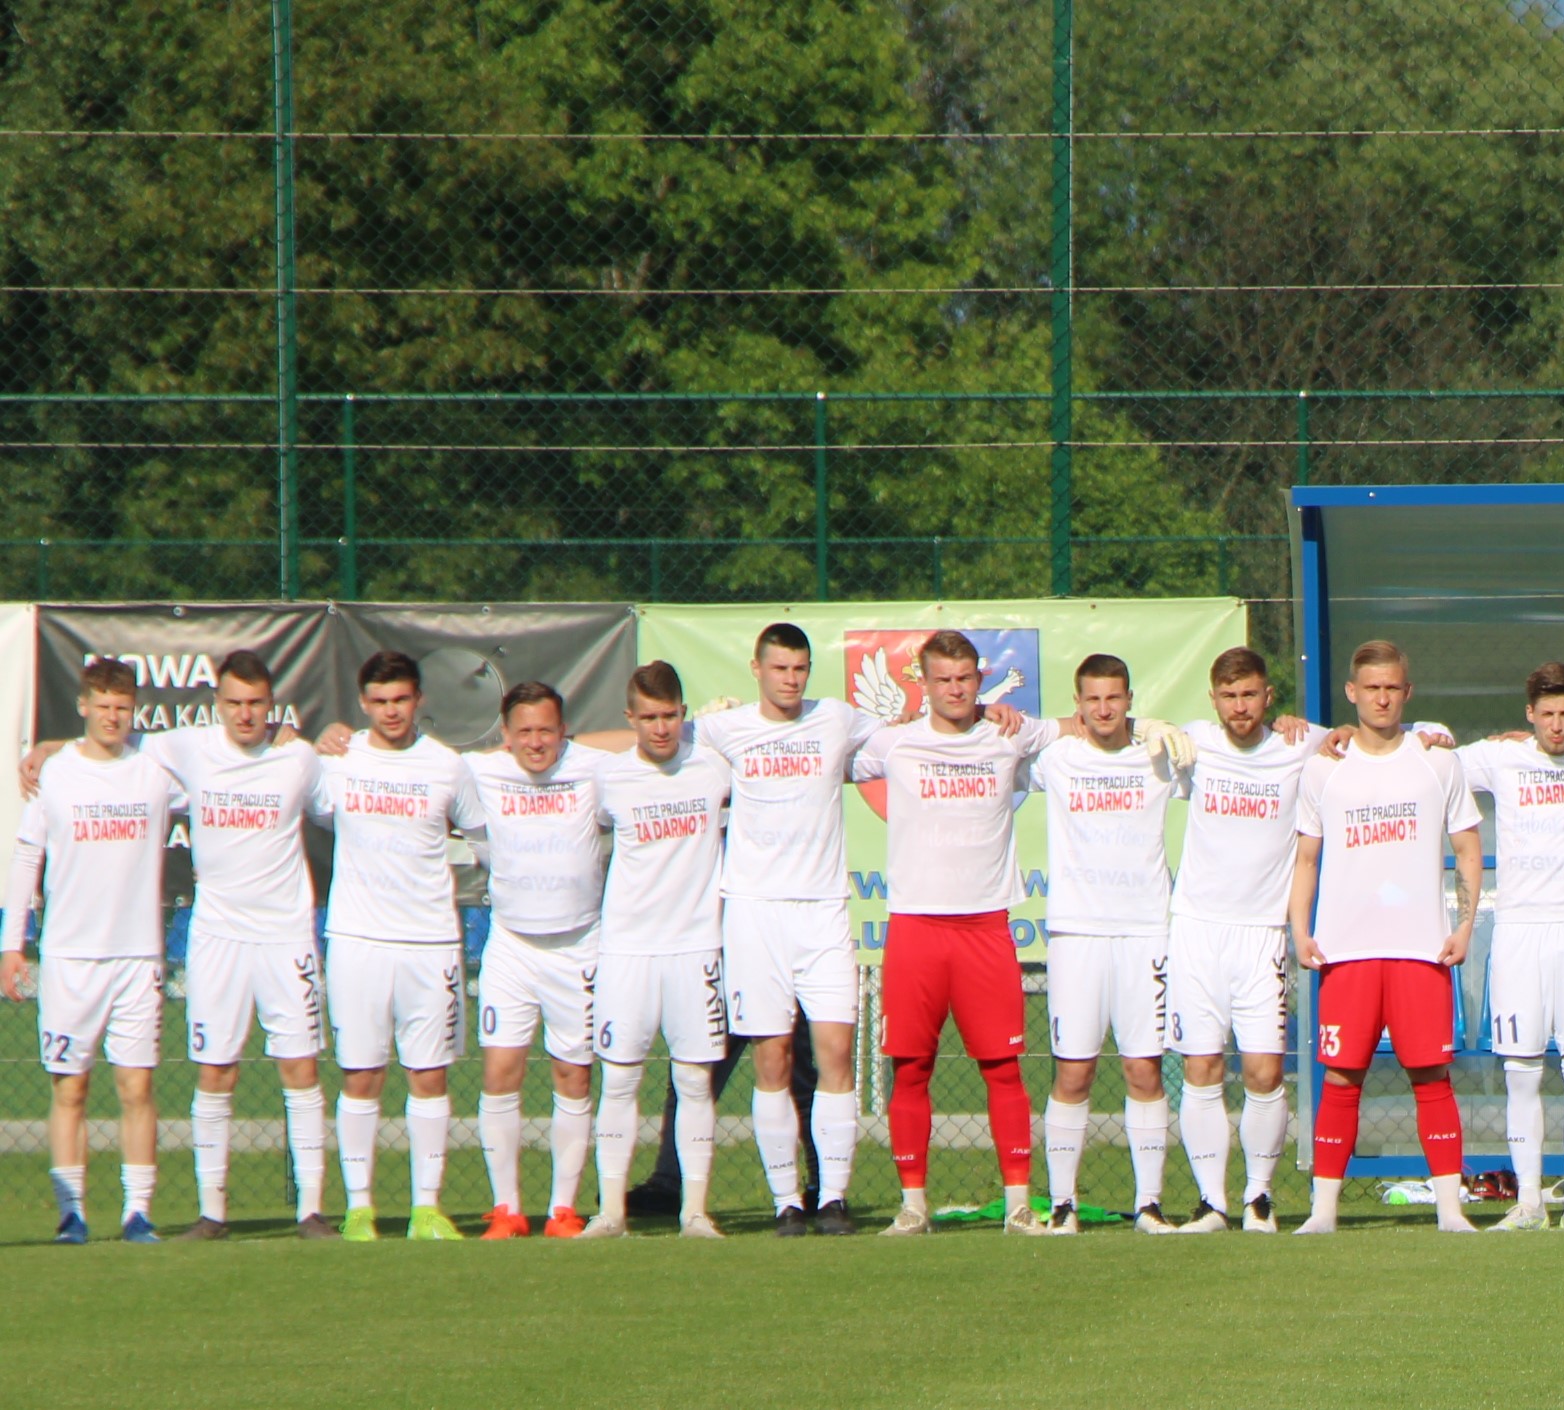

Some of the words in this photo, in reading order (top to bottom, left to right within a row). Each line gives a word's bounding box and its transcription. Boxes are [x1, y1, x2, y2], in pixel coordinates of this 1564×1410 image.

[772, 741, 821, 755] PRACUJESZ
[743, 758, 758, 778] ZA
[762, 756, 809, 778] DARMO
[813, 756, 822, 777] ?!
[919, 763, 931, 777] TY
[932, 763, 948, 777] TEŻ
[950, 762, 996, 776] PRACUJESZ
[1518, 771, 1528, 785] TY
[1529, 768, 1544, 784] TEŻ
[346, 778, 357, 791] TY
[359, 779, 375, 793] TEŻ
[377, 781, 428, 797] PRACUJESZ
[920, 779, 937, 799] ZA
[940, 778, 986, 799] DARMO
[987, 777, 998, 798] ?!
[1069, 777, 1080, 790] TY
[1081, 775, 1096, 791] TEŻ
[1098, 775, 1144, 790] PRACUJESZ
[1206, 777, 1217, 792] TY
[1217, 778, 1232, 794] TEŻ
[1234, 782, 1280, 798] PRACUJESZ
[201, 790, 211, 804] TY
[212, 791, 230, 806] TEŻ
[231, 793, 281, 808] PRACUJESZ
[345, 793, 360, 812] ZA
[364, 794, 416, 817] DARMO
[418, 799, 428, 818] ?!
[501, 796, 516, 816] ZA
[519, 793, 565, 815] DARMO
[567, 793, 577, 812] ?!
[1069, 792, 1084, 813] ZA
[1087, 791, 1133, 812] DARMO
[1135, 790, 1144, 810] ?!
[1205, 793, 1218, 814] ZA
[1222, 796, 1268, 819] DARMO
[1270, 799, 1280, 820] ?!
[1519, 787, 1534, 806] ZA
[73, 805, 82, 818] TY
[85, 802, 100, 818] TEŻ
[101, 803, 147, 818] PRACUJESZ
[201, 807, 216, 827] ZA
[220, 808, 267, 830] DARMO
[268, 810, 279, 830] ?!
[632, 807, 643, 821] TY
[644, 803, 660, 819] TEŻ
[661, 798, 707, 816] PRACUJESZ
[1345, 810, 1355, 825] TY
[1355, 804, 1371, 823] TEŻ
[1372, 802, 1417, 820] PRACUJESZ
[73, 821, 88, 842] ZA
[92, 820, 136, 841] DARMO
[138, 820, 148, 840] ?!
[634, 823, 652, 843] ZA
[652, 815, 697, 840] DARMO
[699, 814, 708, 834] ?!
[1346, 827, 1360, 848] ZA
[1363, 819, 1406, 845] DARMO
[1408, 819, 1417, 841] ?!
[482, 1005, 496, 1036] 0
[1171, 1012, 1182, 1042] 8
[1493, 1013, 1518, 1045] 11
[600, 1020, 611, 1050] 6
[1315, 1135, 1342, 1145] JAKO
[1427, 1132, 1457, 1141] JAKO
